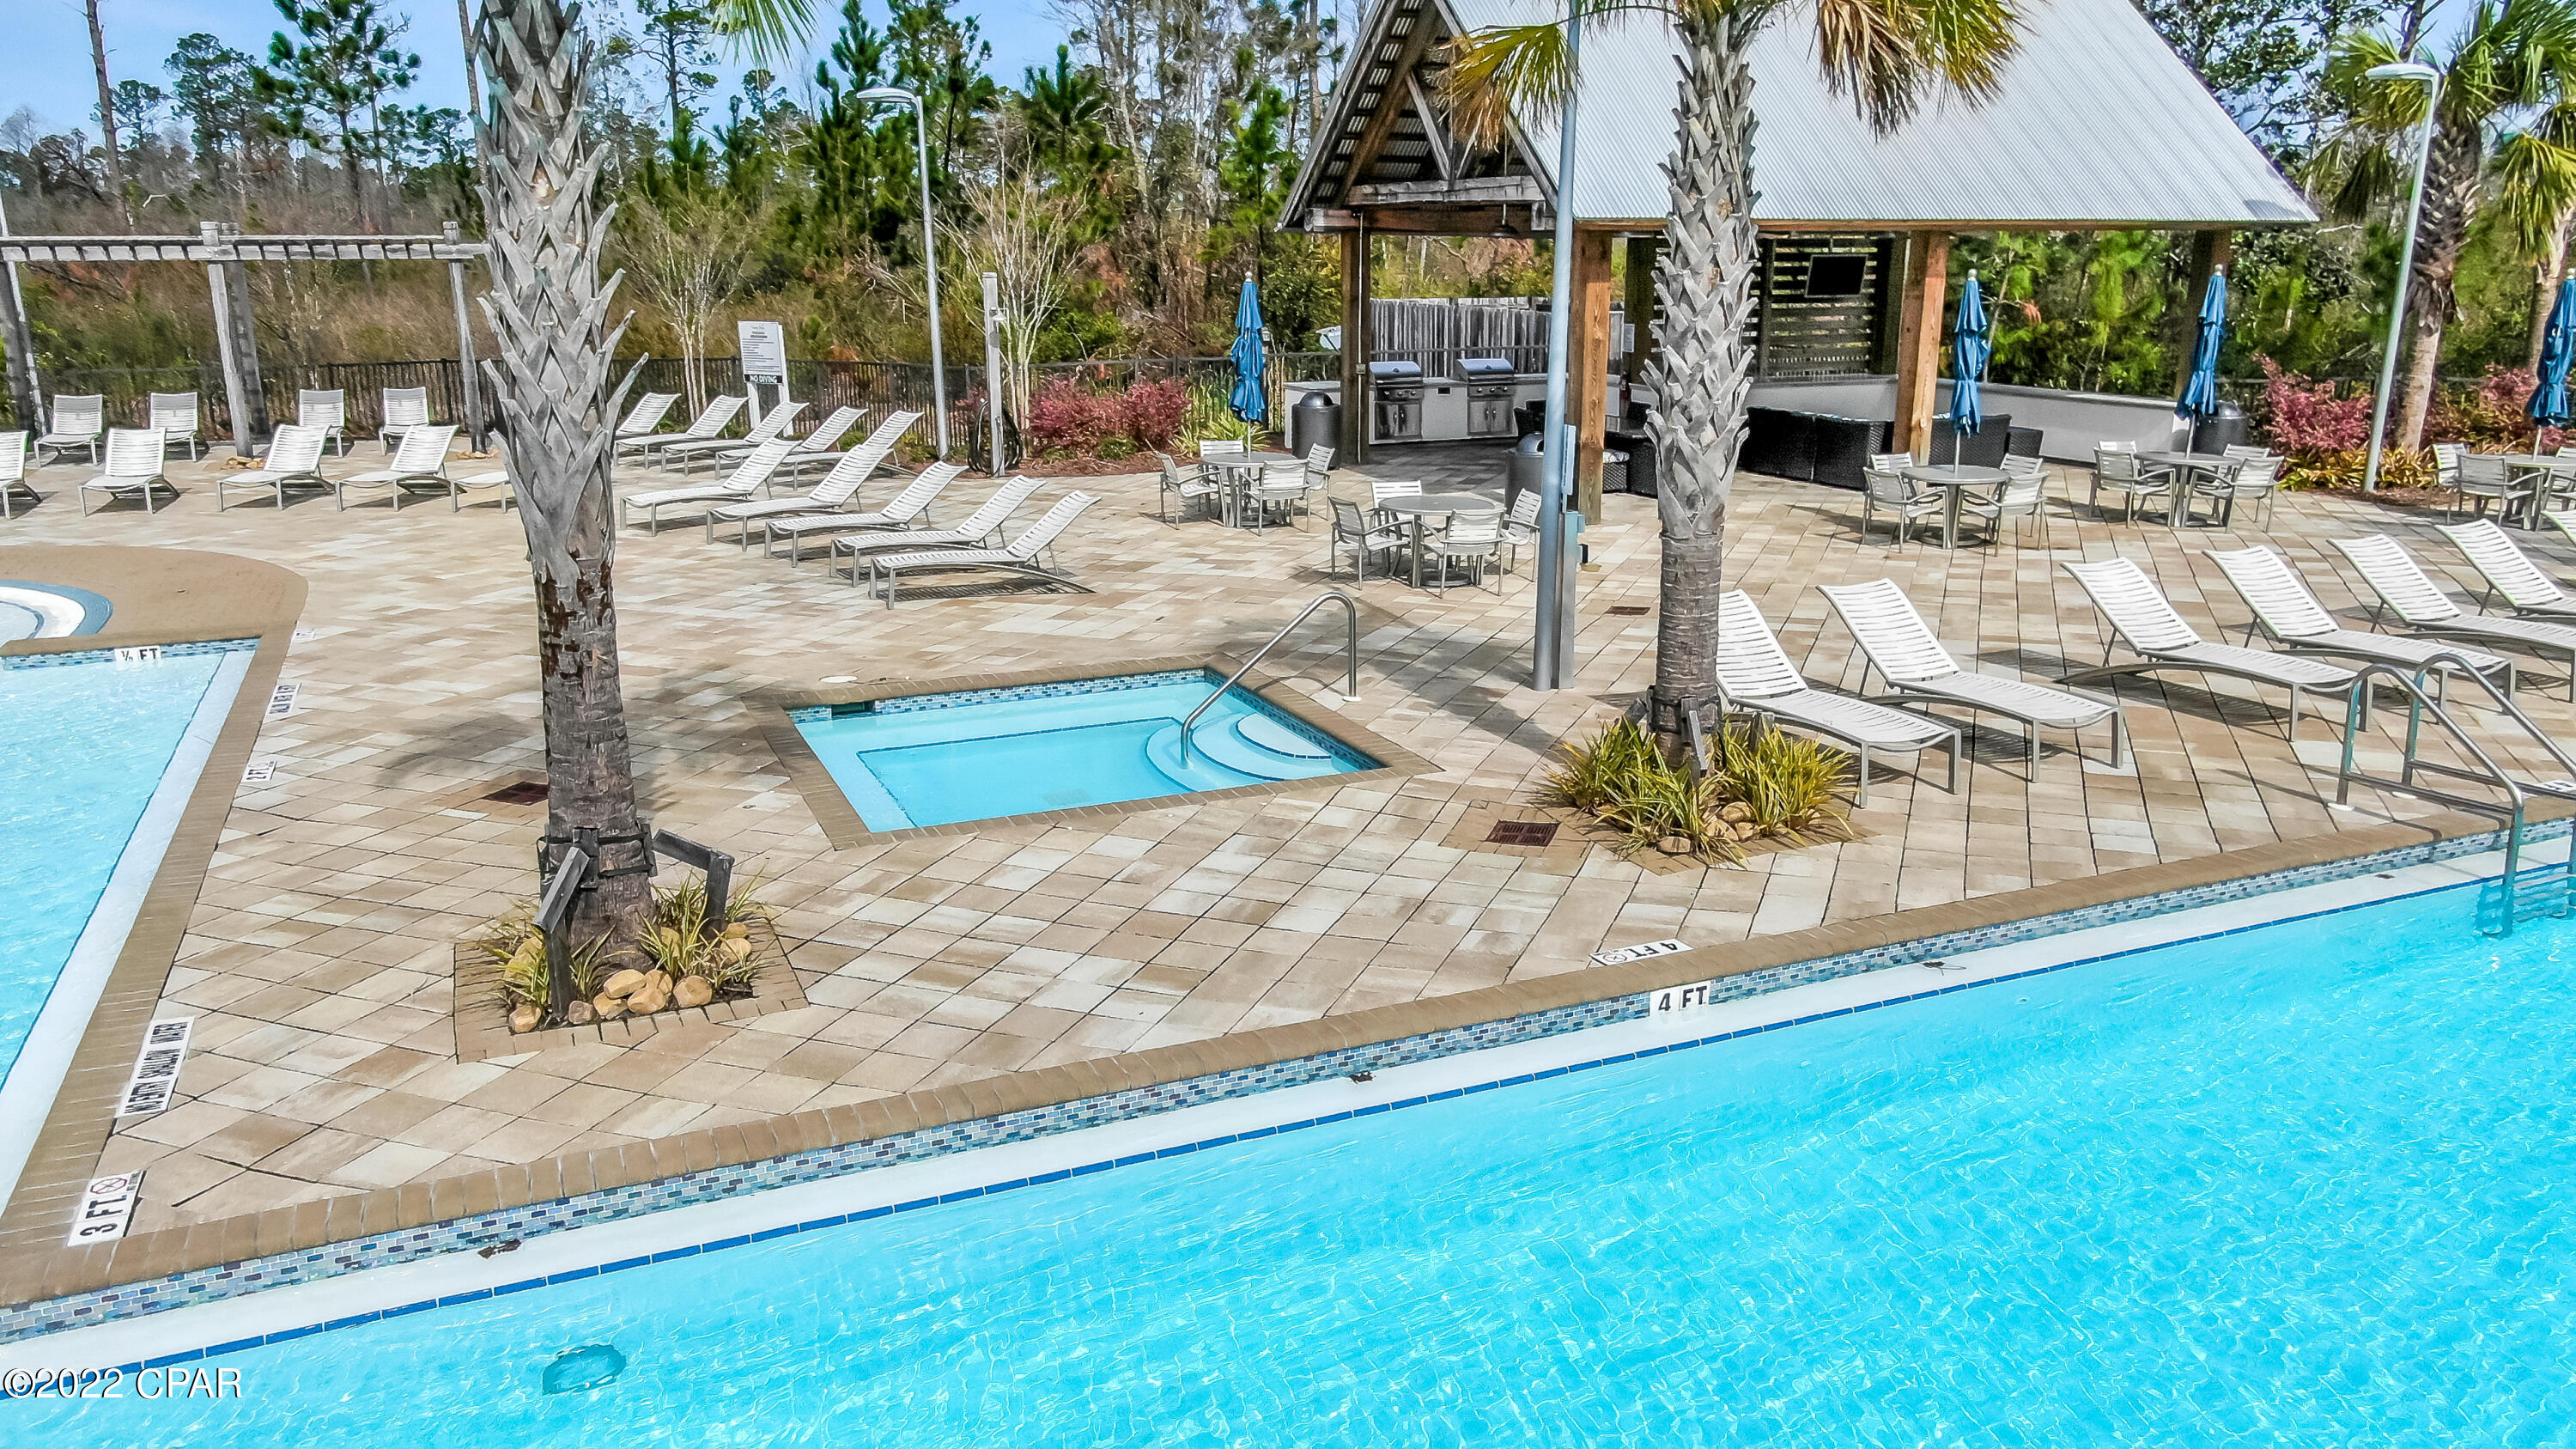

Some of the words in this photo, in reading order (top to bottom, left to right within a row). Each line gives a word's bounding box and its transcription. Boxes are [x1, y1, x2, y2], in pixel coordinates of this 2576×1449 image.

[750, 374, 758, 383] NO
[139, 648, 157, 661] FT
[1660, 942, 1678, 951] 4
[1658, 992, 1671, 1011] 4
[150, 1021, 188, 1045] WATER
[137, 1048, 181, 1080] SHALLOW
[128, 1080, 170, 1103] ENTRY
[124, 1100, 164, 1114] NO
[79, 1222, 118, 1236] 3
